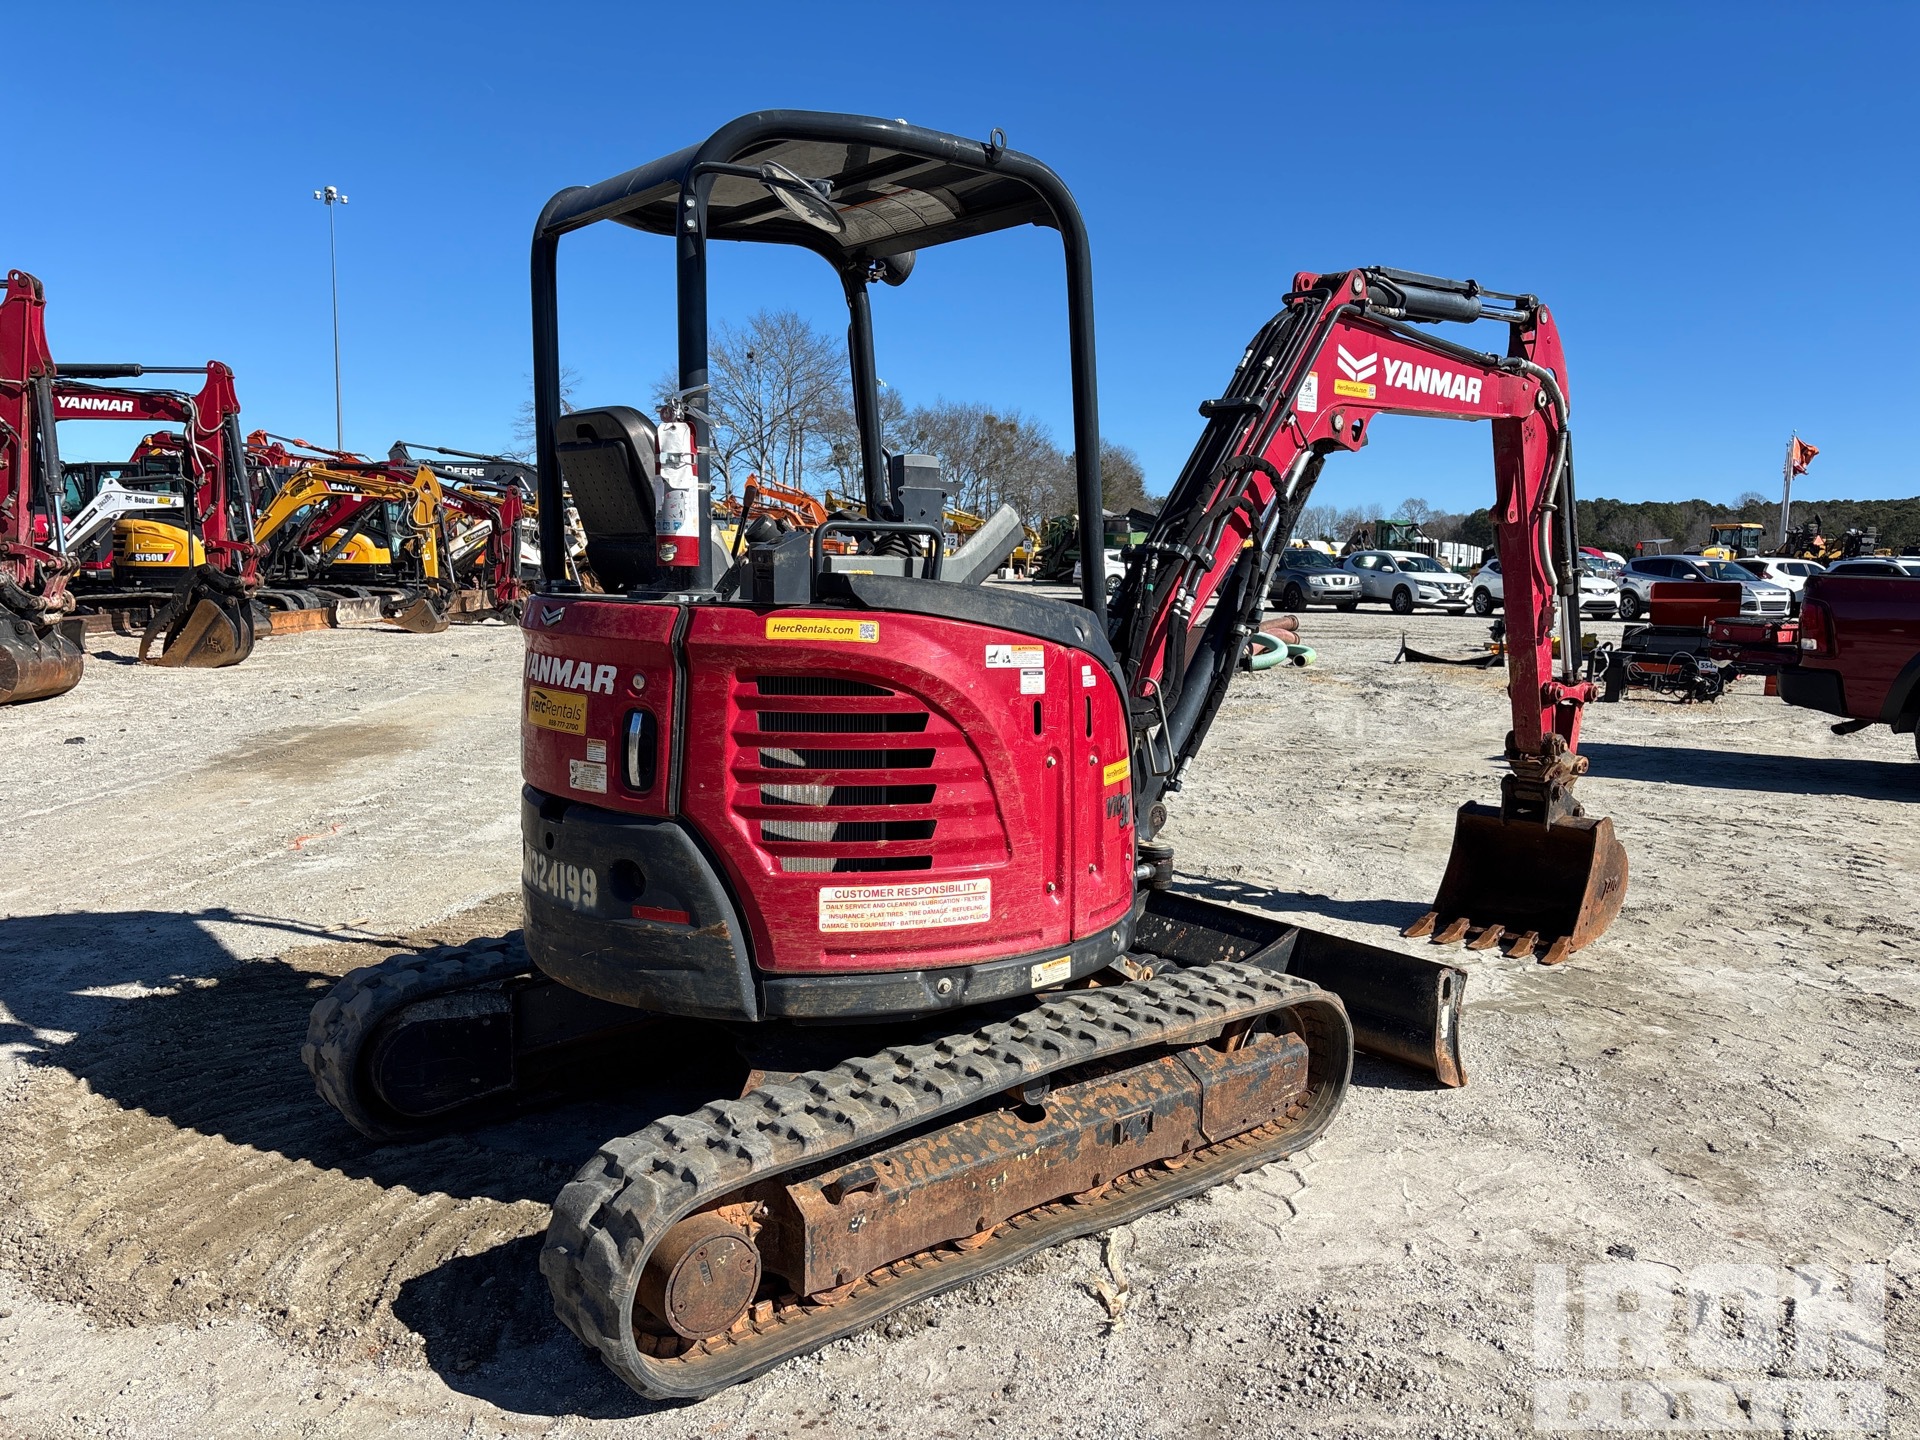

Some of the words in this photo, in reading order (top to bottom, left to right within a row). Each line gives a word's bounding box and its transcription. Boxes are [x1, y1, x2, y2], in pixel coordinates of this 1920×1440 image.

[1383, 356, 1483, 404] YANMAR
[57, 396, 134, 413] YANMAR
[445, 465, 485, 477] DEERE
[330, 483, 357, 492] SANY
[134, 496, 155, 505] Bobcat
[947, 538, 955, 546] 12
[135, 553, 164, 561] SY50U
[773, 624, 854, 635] HercRentals.com
[526, 652, 617, 695] YANMAR
[531, 696, 582, 720] HercRentals
[834, 889, 894, 899] CUSTOMER
[897, 882, 978, 896] RESPONSIBILITY
[922, 897, 960, 906] LUBRICATION
[923, 907, 948, 915] DAMAGE
[952, 905, 983, 913] REFUELING
